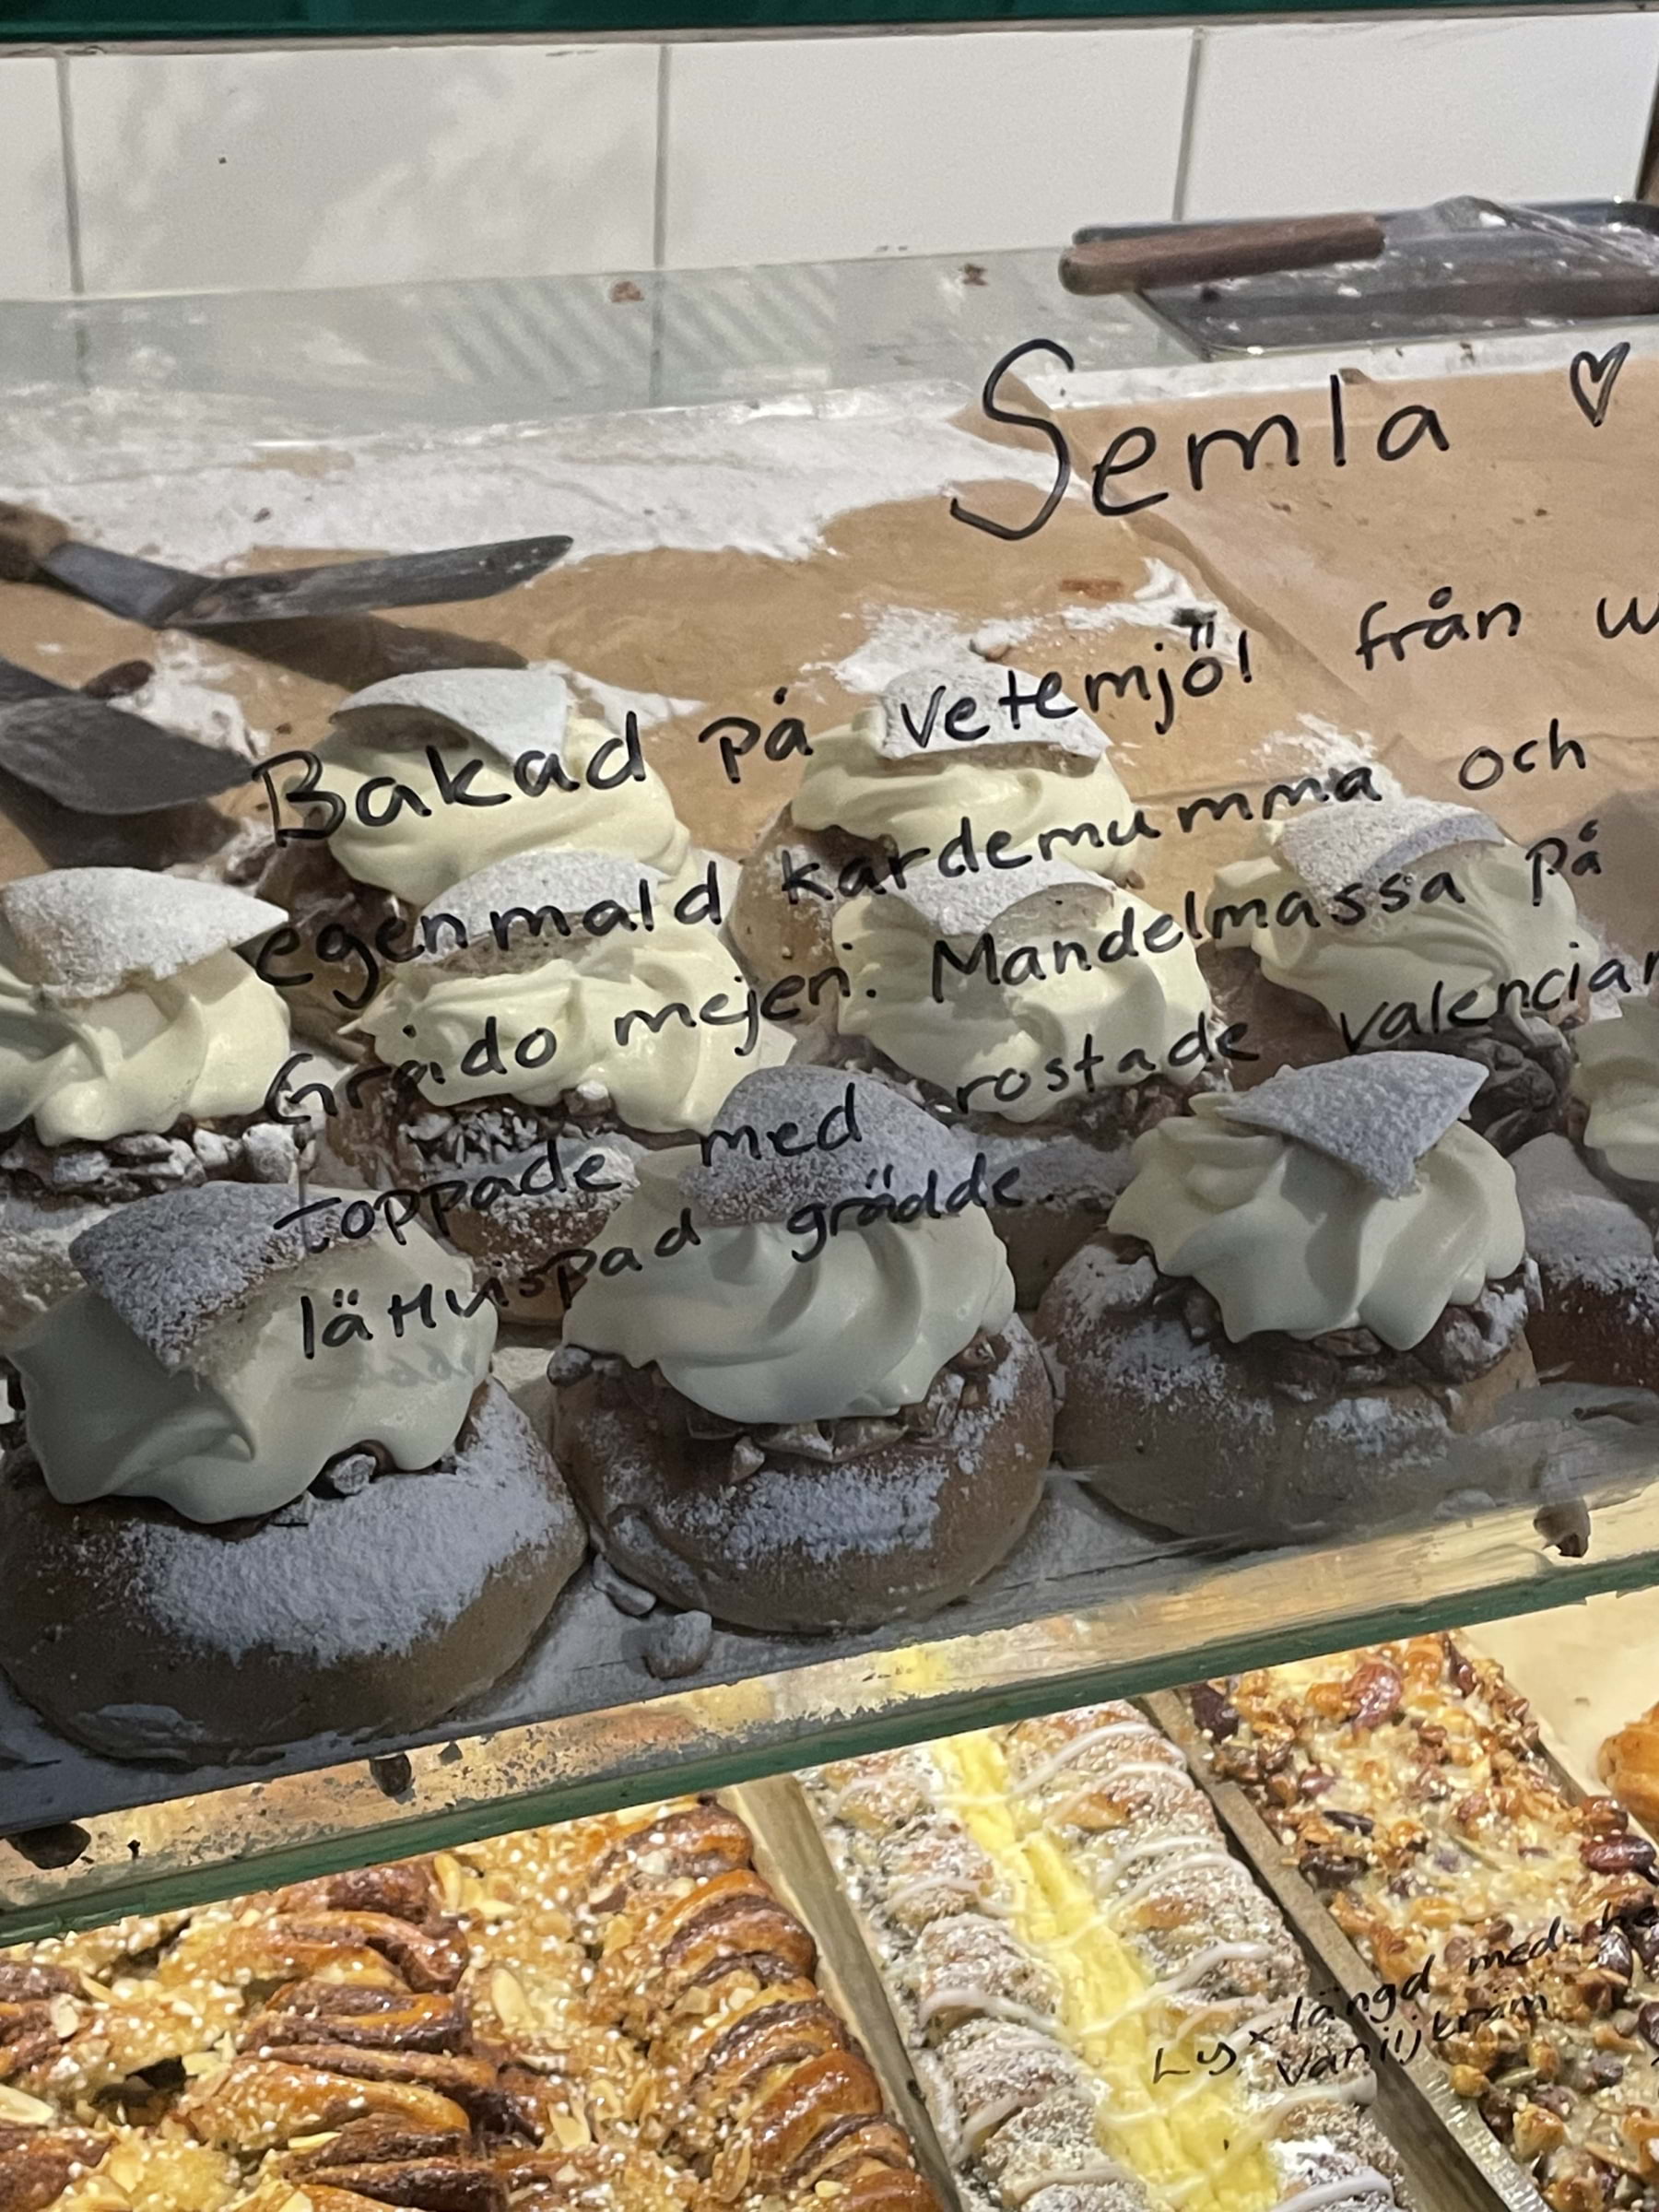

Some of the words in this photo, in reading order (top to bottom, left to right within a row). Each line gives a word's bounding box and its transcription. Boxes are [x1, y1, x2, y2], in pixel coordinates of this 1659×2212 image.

[949, 337, 1451, 542] Semla
[252, 710, 645, 847] Bakad
[698, 686, 814, 783] på
[1355, 585, 1522, 671] från
[781, 765, 1382, 905] kardemumma
[1458, 717, 1586, 791] och
[930, 869, 1466, 1004] Mandelmassa
[1524, 818, 1602, 908] på
[699, 1081, 863, 1168] med
[955, 1011, 1260, 1114] rostade
[1467, 1915, 1559, 1976] med
